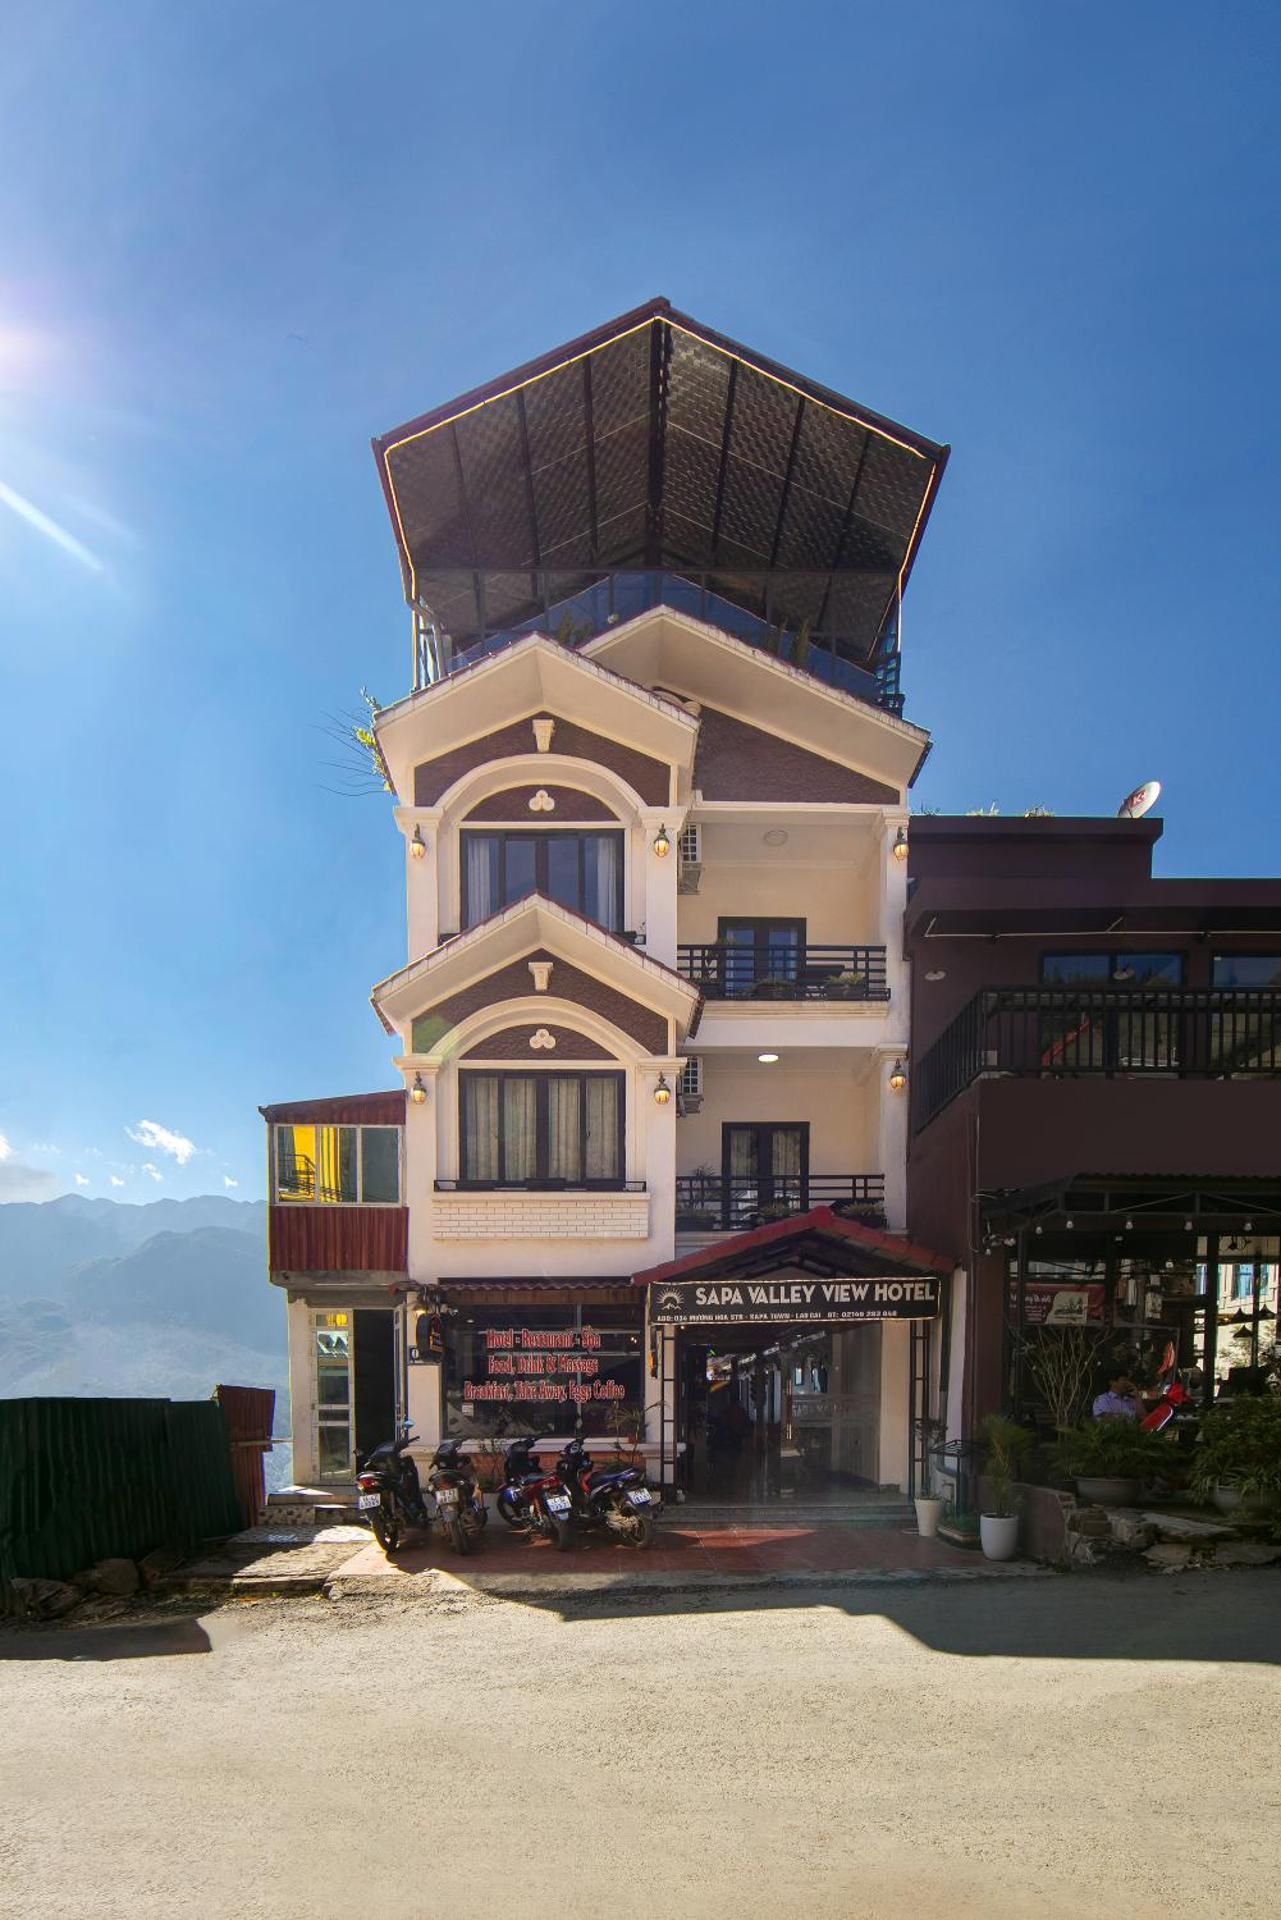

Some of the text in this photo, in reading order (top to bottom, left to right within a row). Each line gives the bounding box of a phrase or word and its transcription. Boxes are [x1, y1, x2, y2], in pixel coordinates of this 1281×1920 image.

[695, 1283, 935, 1305] SAPA VALLEY VIEW HOTEL
[486, 1328, 514, 1348] Hotel
[521, 1328, 574, 1348] Restaurant
[581, 1325, 601, 1350] Spa
[488, 1353, 599, 1376] Food, Drink & Massage
[463, 1381, 513, 1401] Breakfast,
[514, 1381, 537, 1400] Take
[594, 1380, 626, 1400] Coffee
